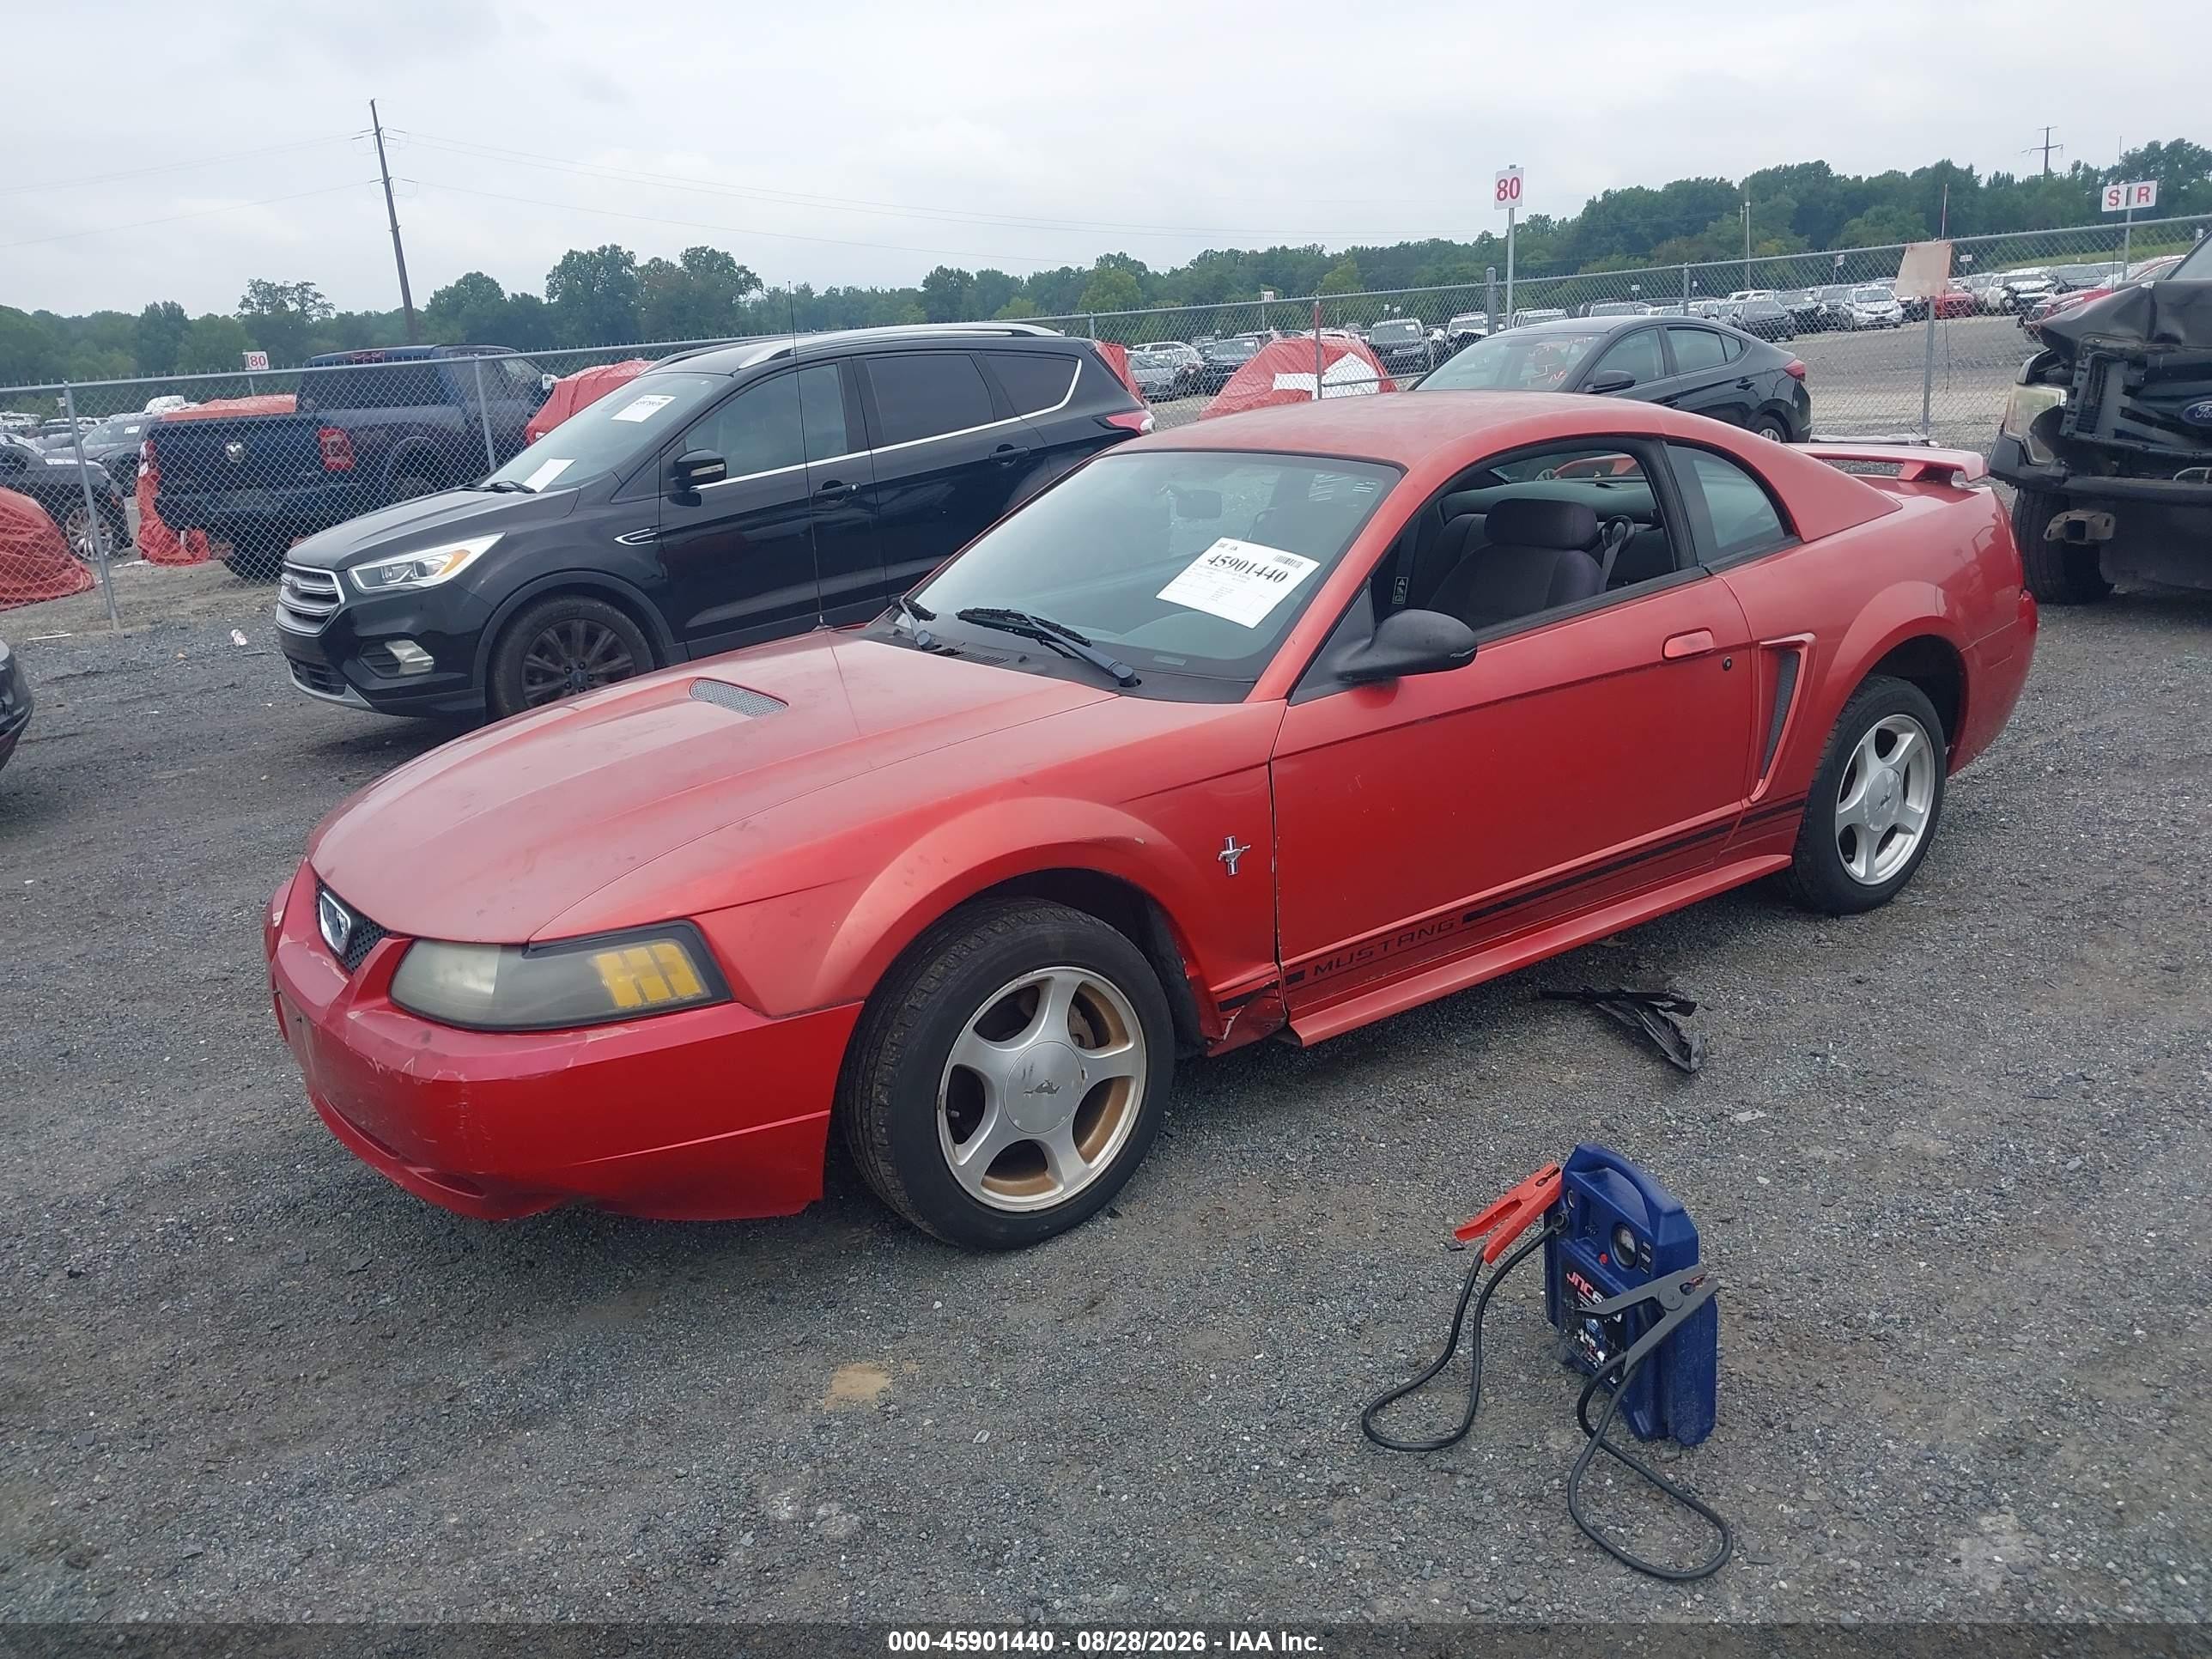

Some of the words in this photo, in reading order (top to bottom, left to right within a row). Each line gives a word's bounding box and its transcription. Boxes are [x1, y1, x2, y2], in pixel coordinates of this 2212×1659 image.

[1497, 176, 1521, 202] 80
[250, 356, 266, 367] 80
[1207, 554, 1289, 584] 45901440
[1313, 917, 1455, 976] MUSTANG
